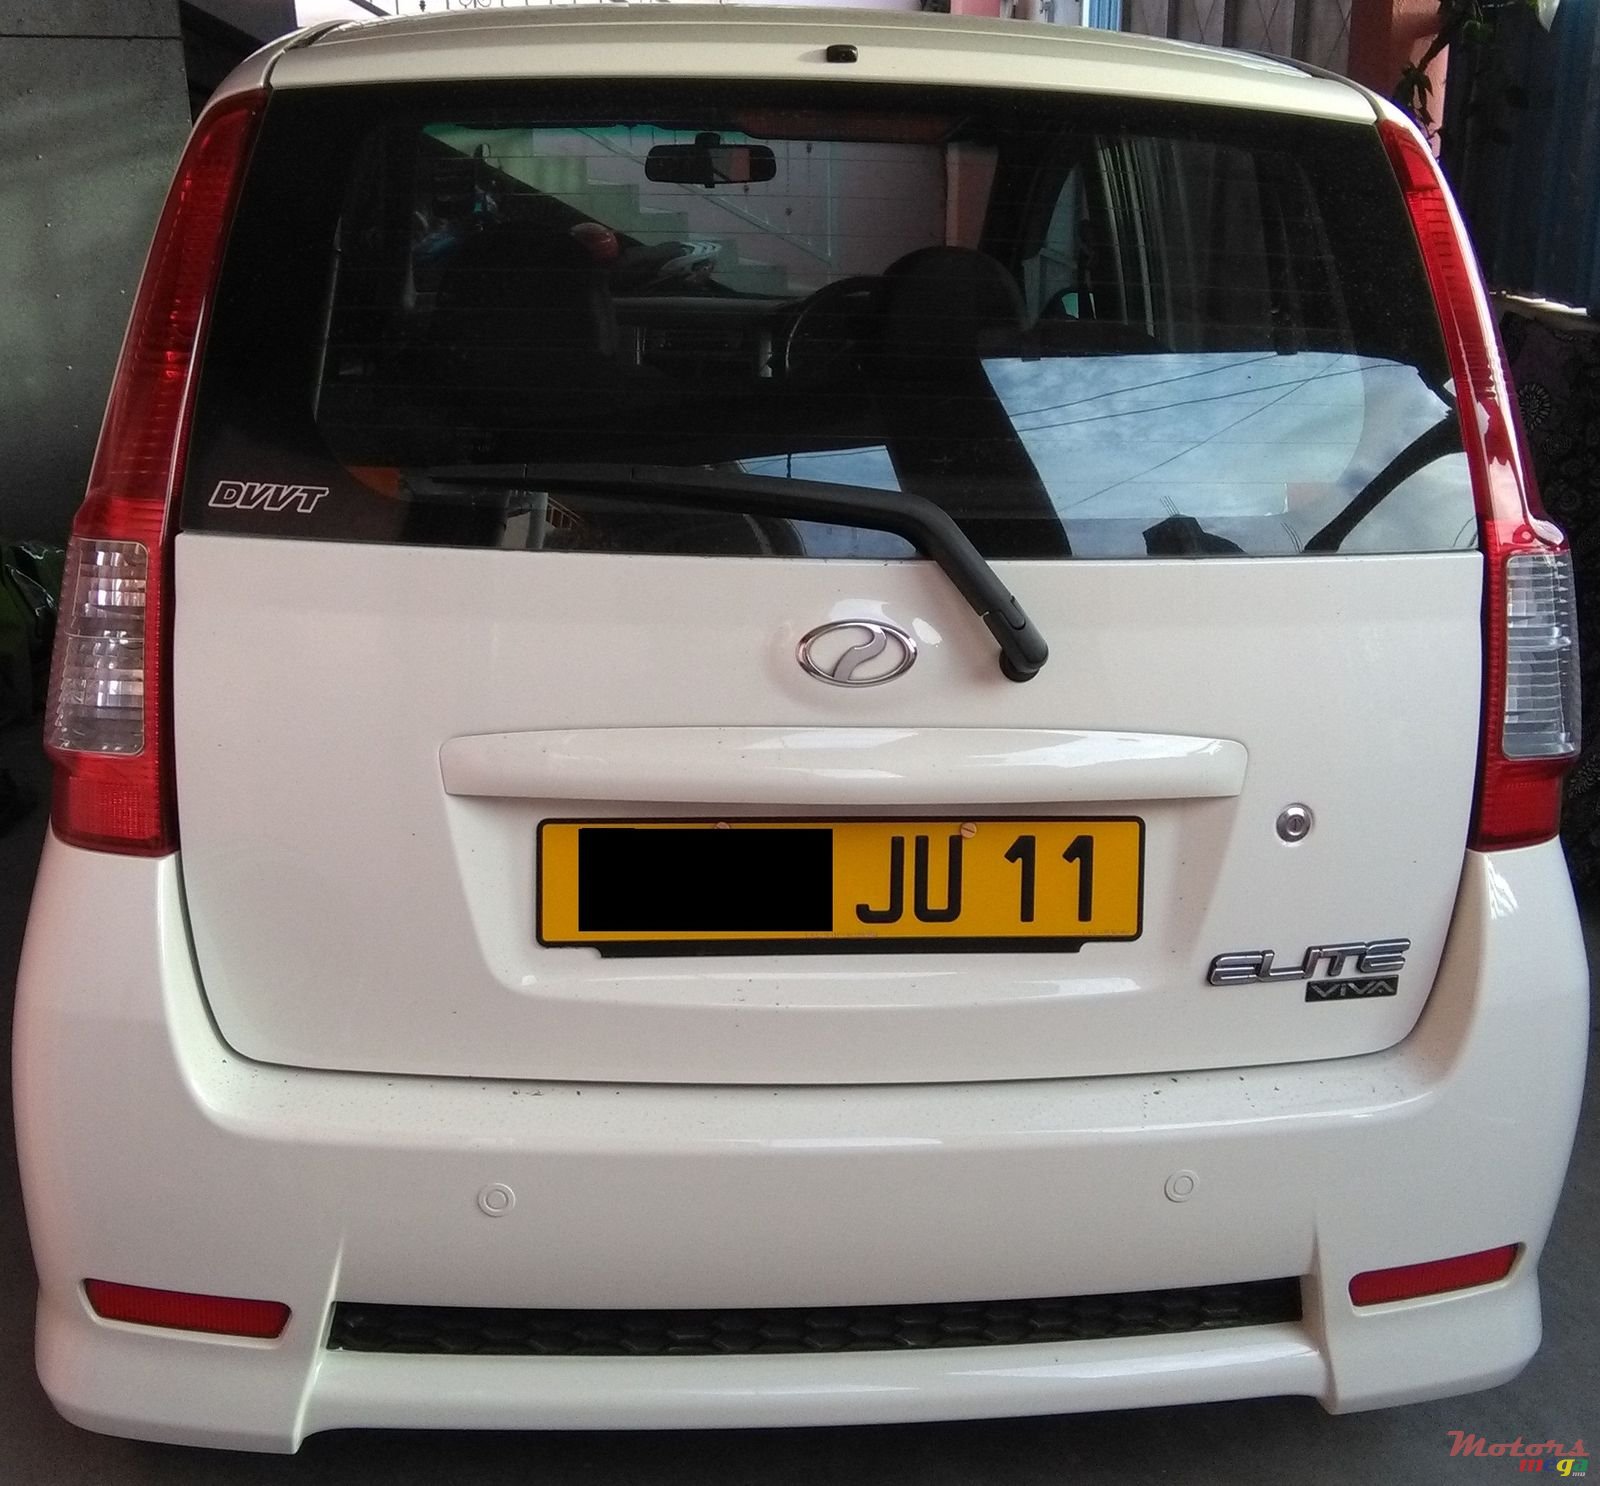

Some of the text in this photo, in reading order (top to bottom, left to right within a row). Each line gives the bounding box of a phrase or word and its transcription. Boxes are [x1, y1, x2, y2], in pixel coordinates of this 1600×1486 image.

[208, 480, 330, 513] DVVT
[856, 834, 1095, 924] JU 11
[1206, 938, 1411, 986] ELITE
[1309, 978, 1397, 1000] VIVA
